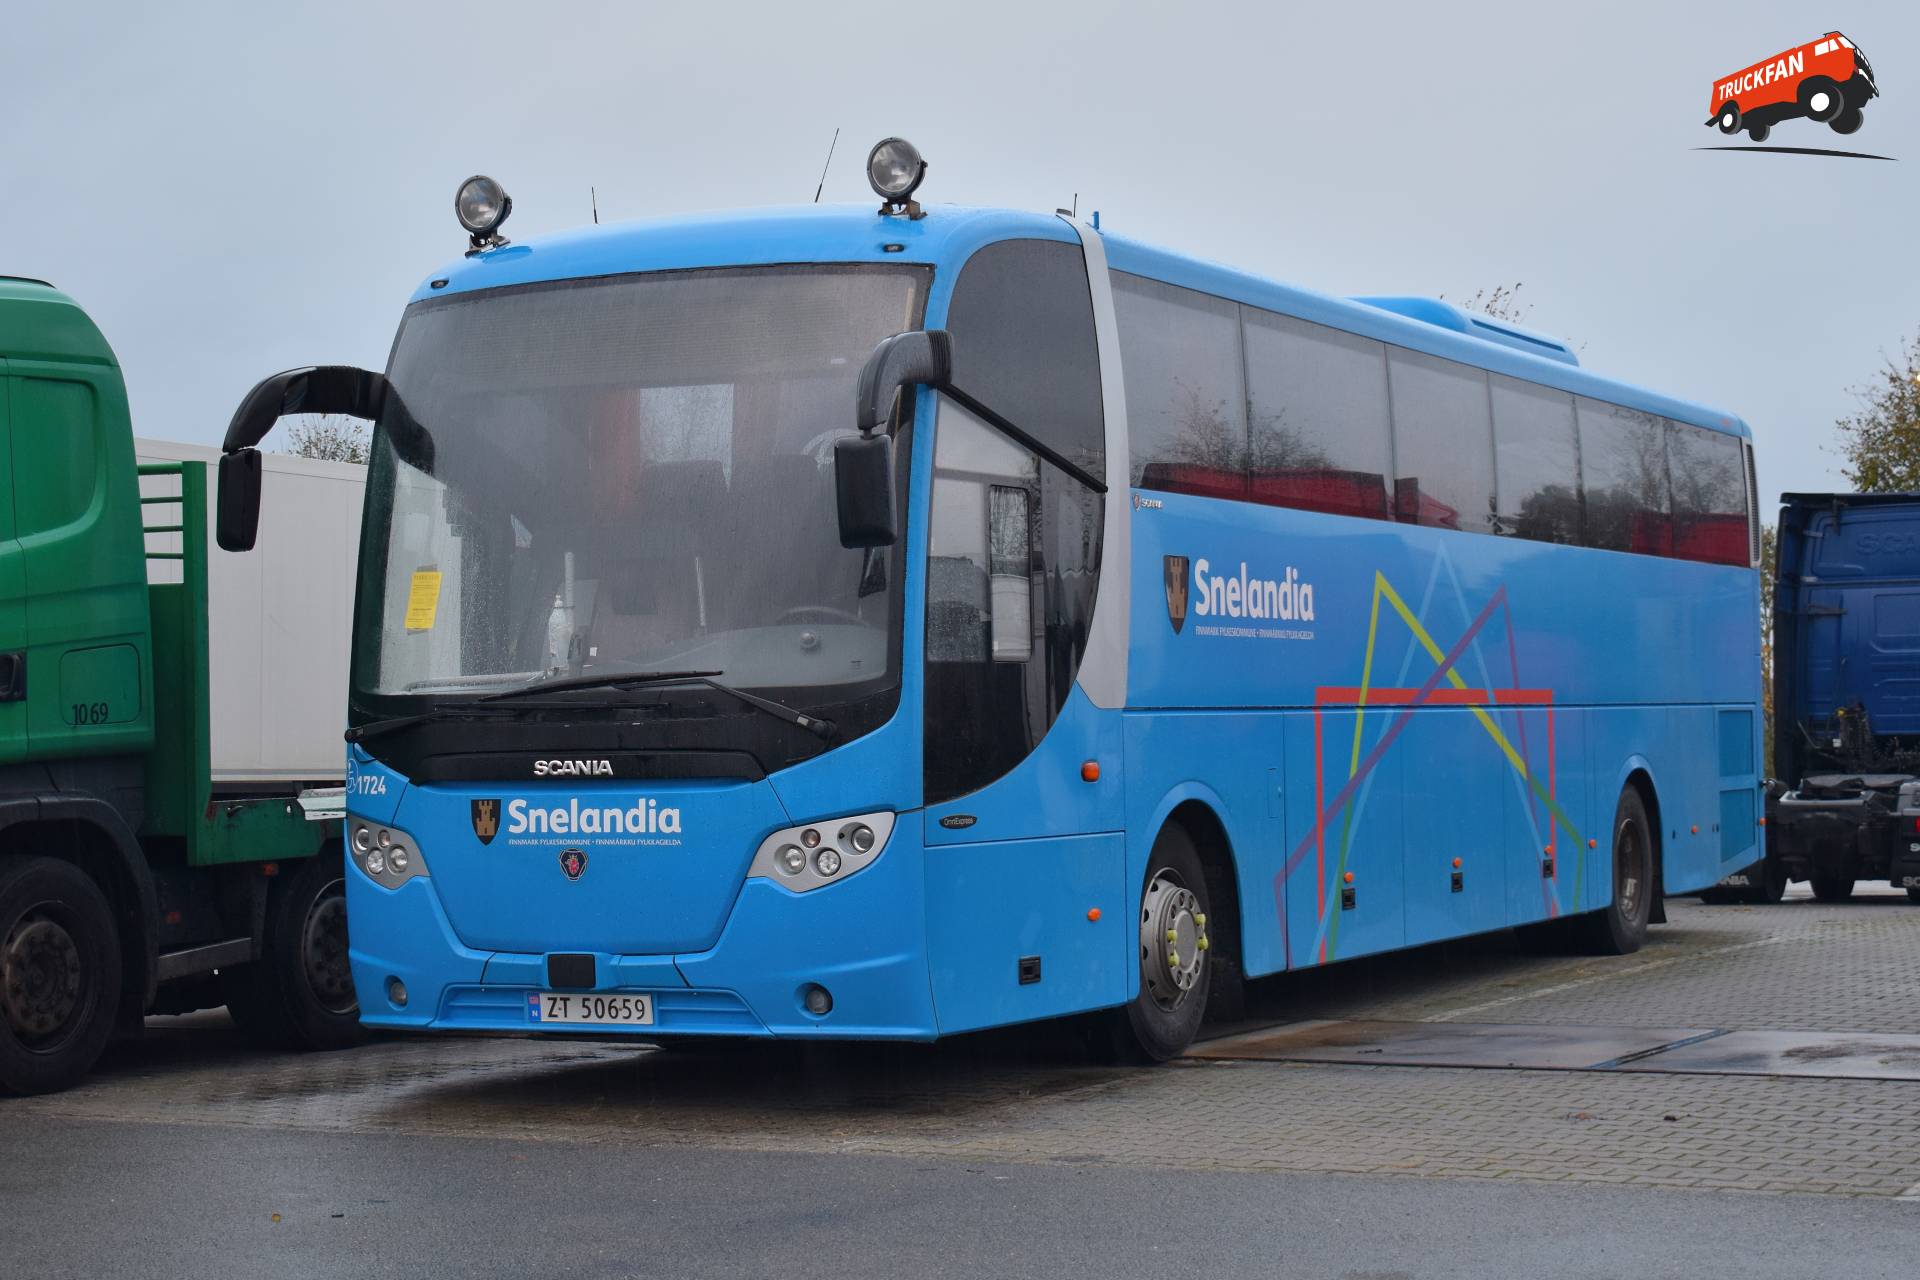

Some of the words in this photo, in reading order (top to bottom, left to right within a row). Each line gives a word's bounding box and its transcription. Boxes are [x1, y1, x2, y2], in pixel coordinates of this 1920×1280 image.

[1195, 558, 1315, 621] Snelandia
[533, 760, 614, 776] SCANIA
[357, 775, 387, 795] 1724
[508, 798, 682, 834] Snelandia
[508, 838, 539, 846] FINNMARK
[547, 997, 571, 1018] ZT
[581, 997, 646, 1020] 50659
